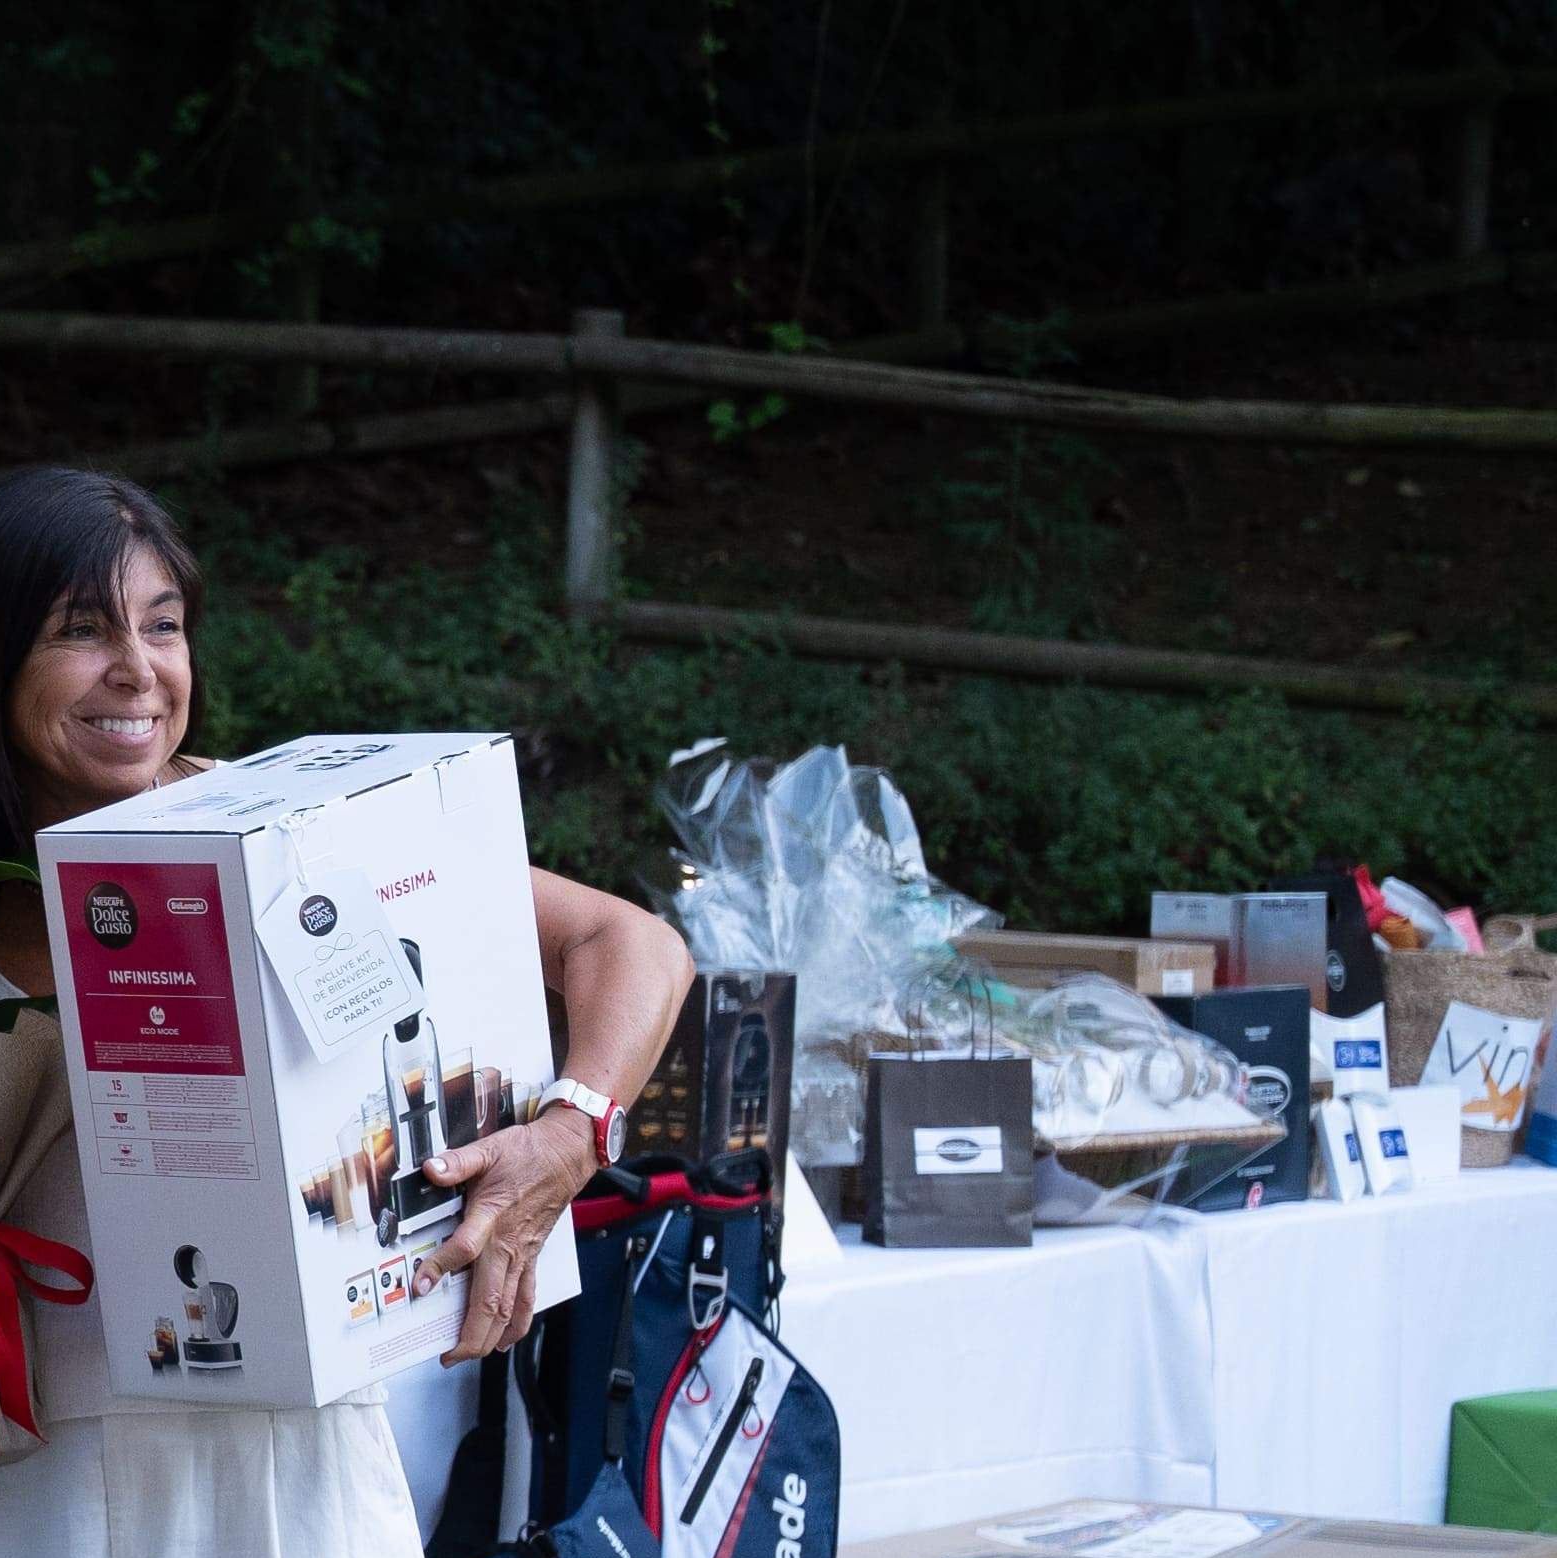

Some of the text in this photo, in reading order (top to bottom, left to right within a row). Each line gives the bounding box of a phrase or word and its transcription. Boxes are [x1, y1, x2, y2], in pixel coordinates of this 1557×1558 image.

[376, 869, 436, 903] NISSIMA
[92, 907, 130, 922] Dolce
[304, 906, 332, 926] Dolce
[308, 914, 335, 932] Gusto
[94, 920, 132, 935] Gusto
[108, 969, 197, 986] INFINISSIMA
[314, 950, 372, 987] INCLUYE KIT
[312, 958, 386, 1002] DE BIENVENIDA
[349, 977, 394, 1006] REGALOS
[343, 1006, 370, 1024] PARA
[111, 1079, 122, 1091] 15
